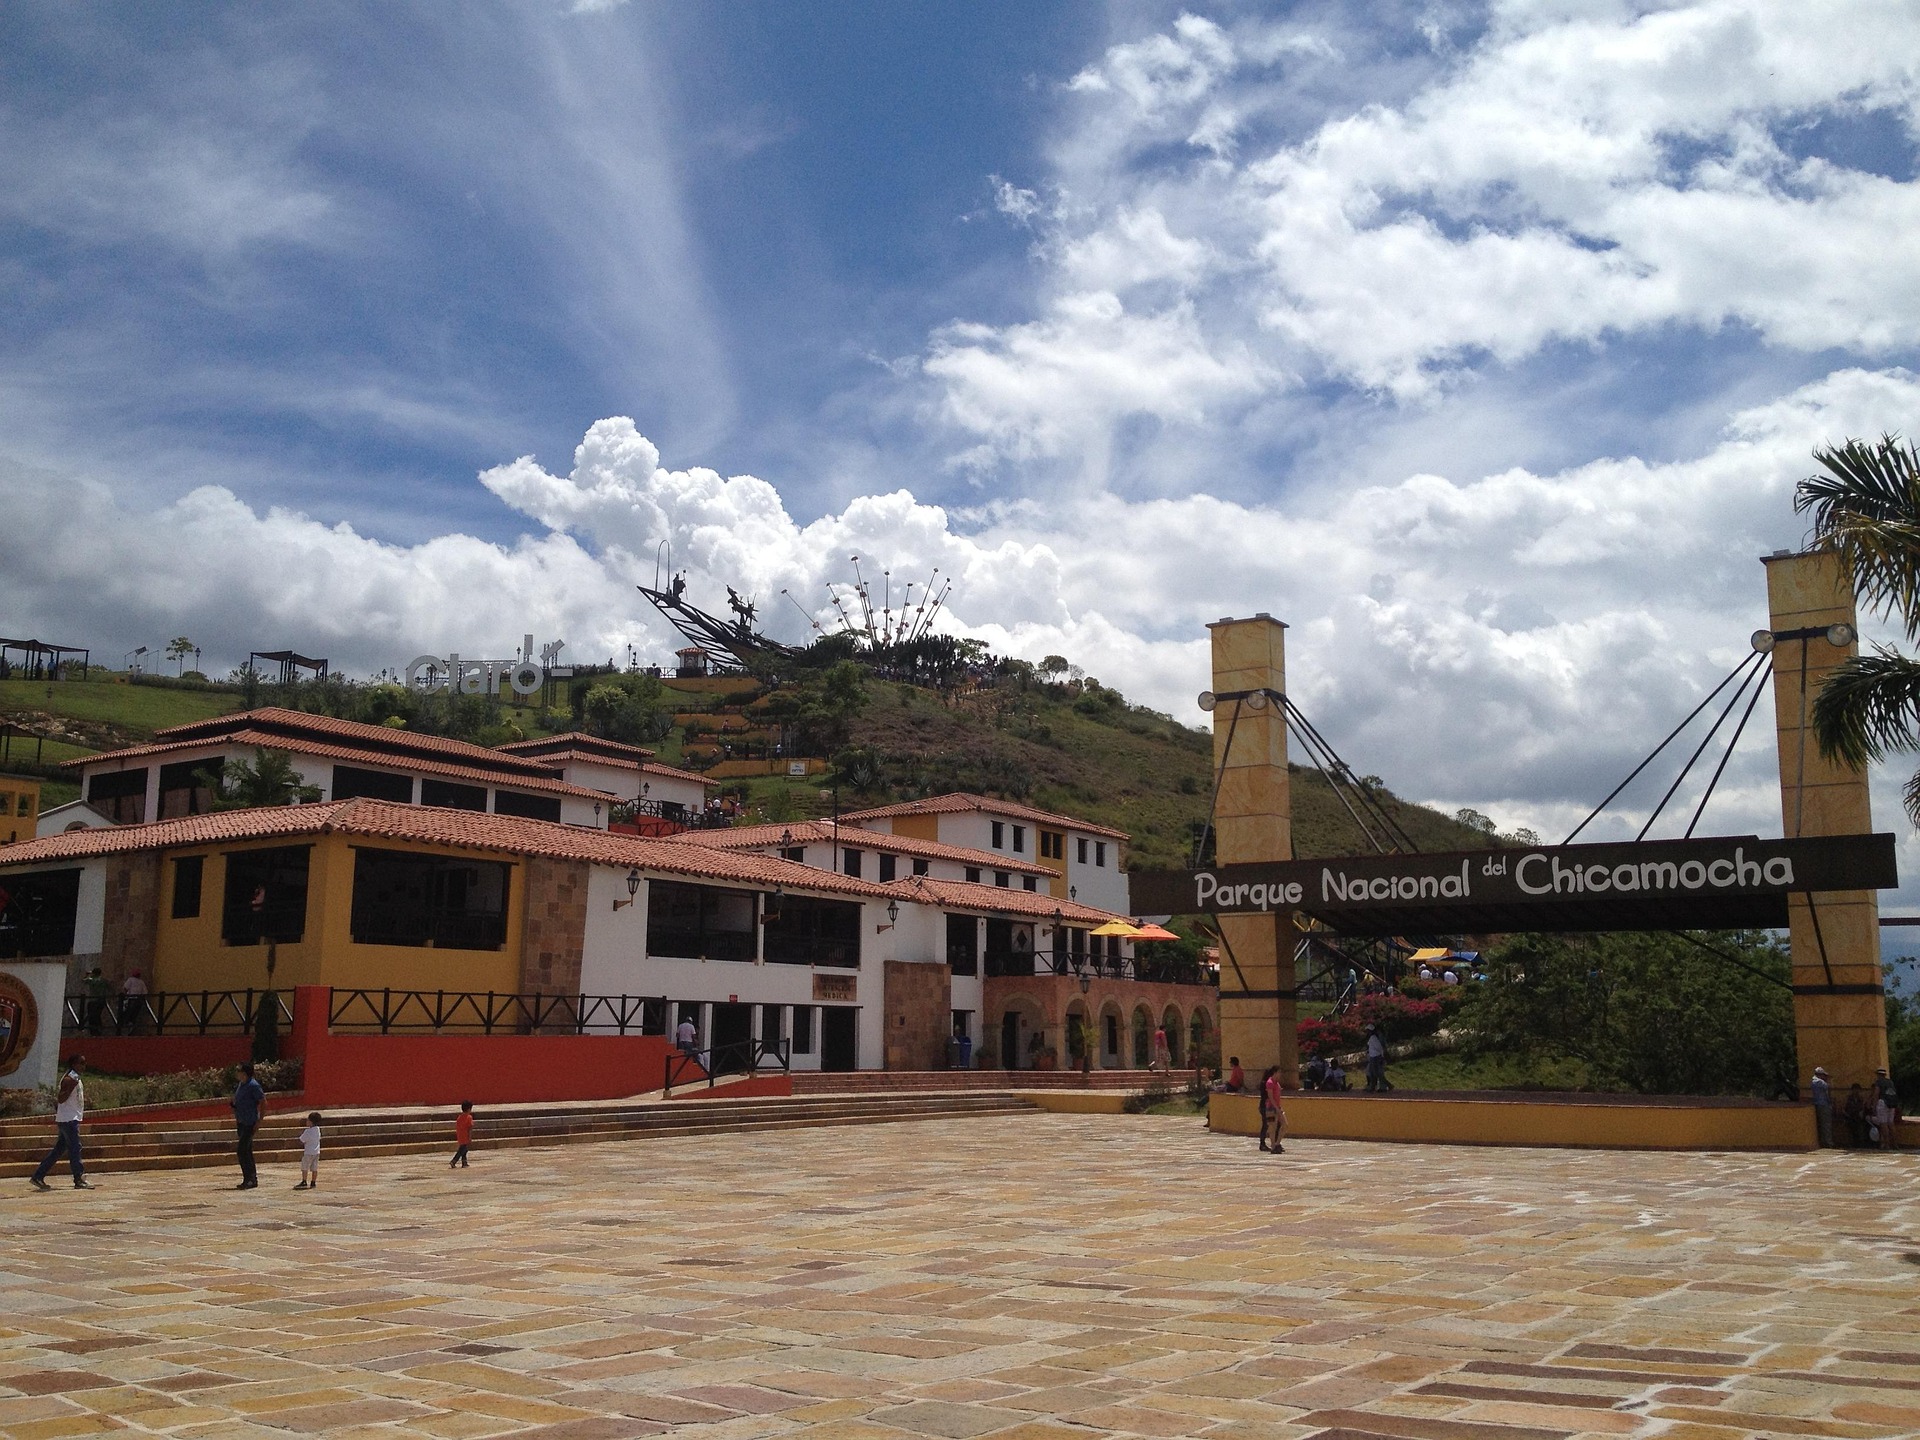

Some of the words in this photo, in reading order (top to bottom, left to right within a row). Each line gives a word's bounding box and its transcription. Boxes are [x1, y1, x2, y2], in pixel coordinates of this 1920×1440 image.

[406, 653, 545, 695] Claro
[1194, 872, 1303, 912] Parque
[1322, 859, 1471, 902] Nacional
[1482, 856, 1507, 876] del
[1515, 847, 1795, 895] Chicamocha
